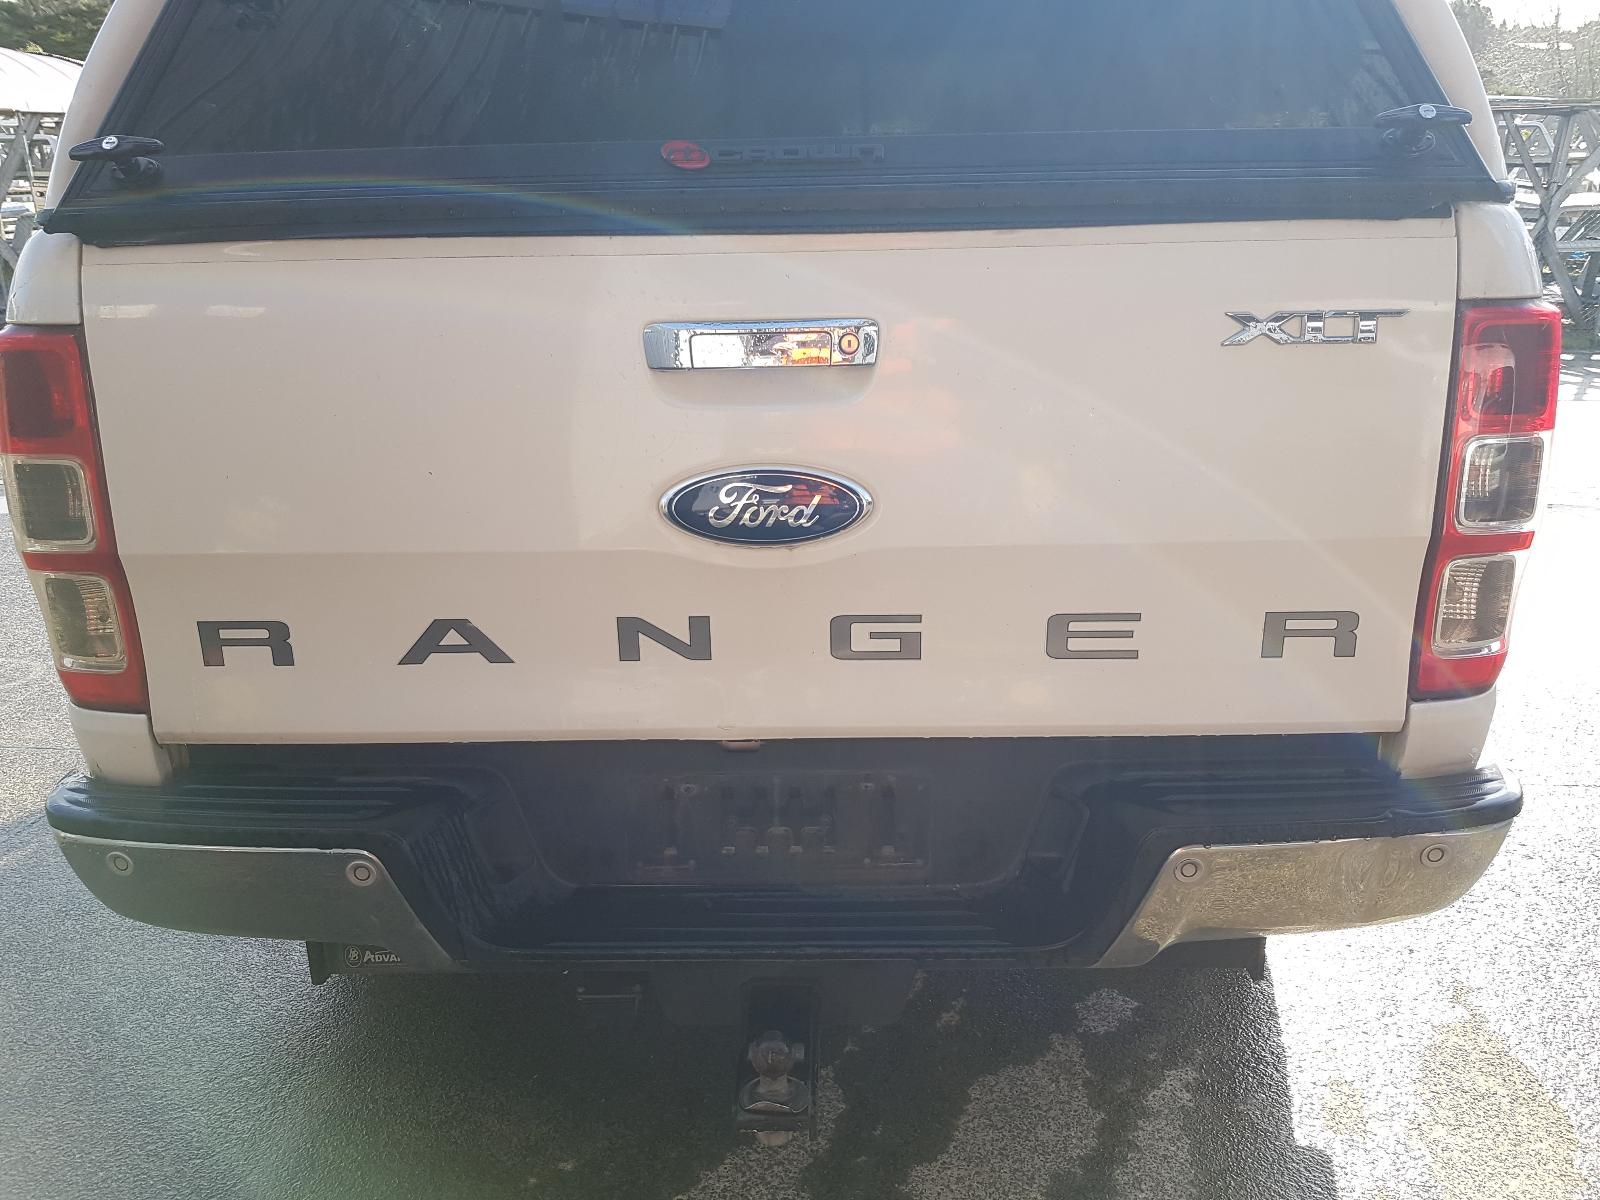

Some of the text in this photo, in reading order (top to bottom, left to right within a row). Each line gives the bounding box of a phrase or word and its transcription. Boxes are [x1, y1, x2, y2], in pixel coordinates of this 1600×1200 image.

[1221, 309, 1410, 346] XLT
[708, 483, 821, 528] Ford
[197, 611, 1359, 666] RANGER
